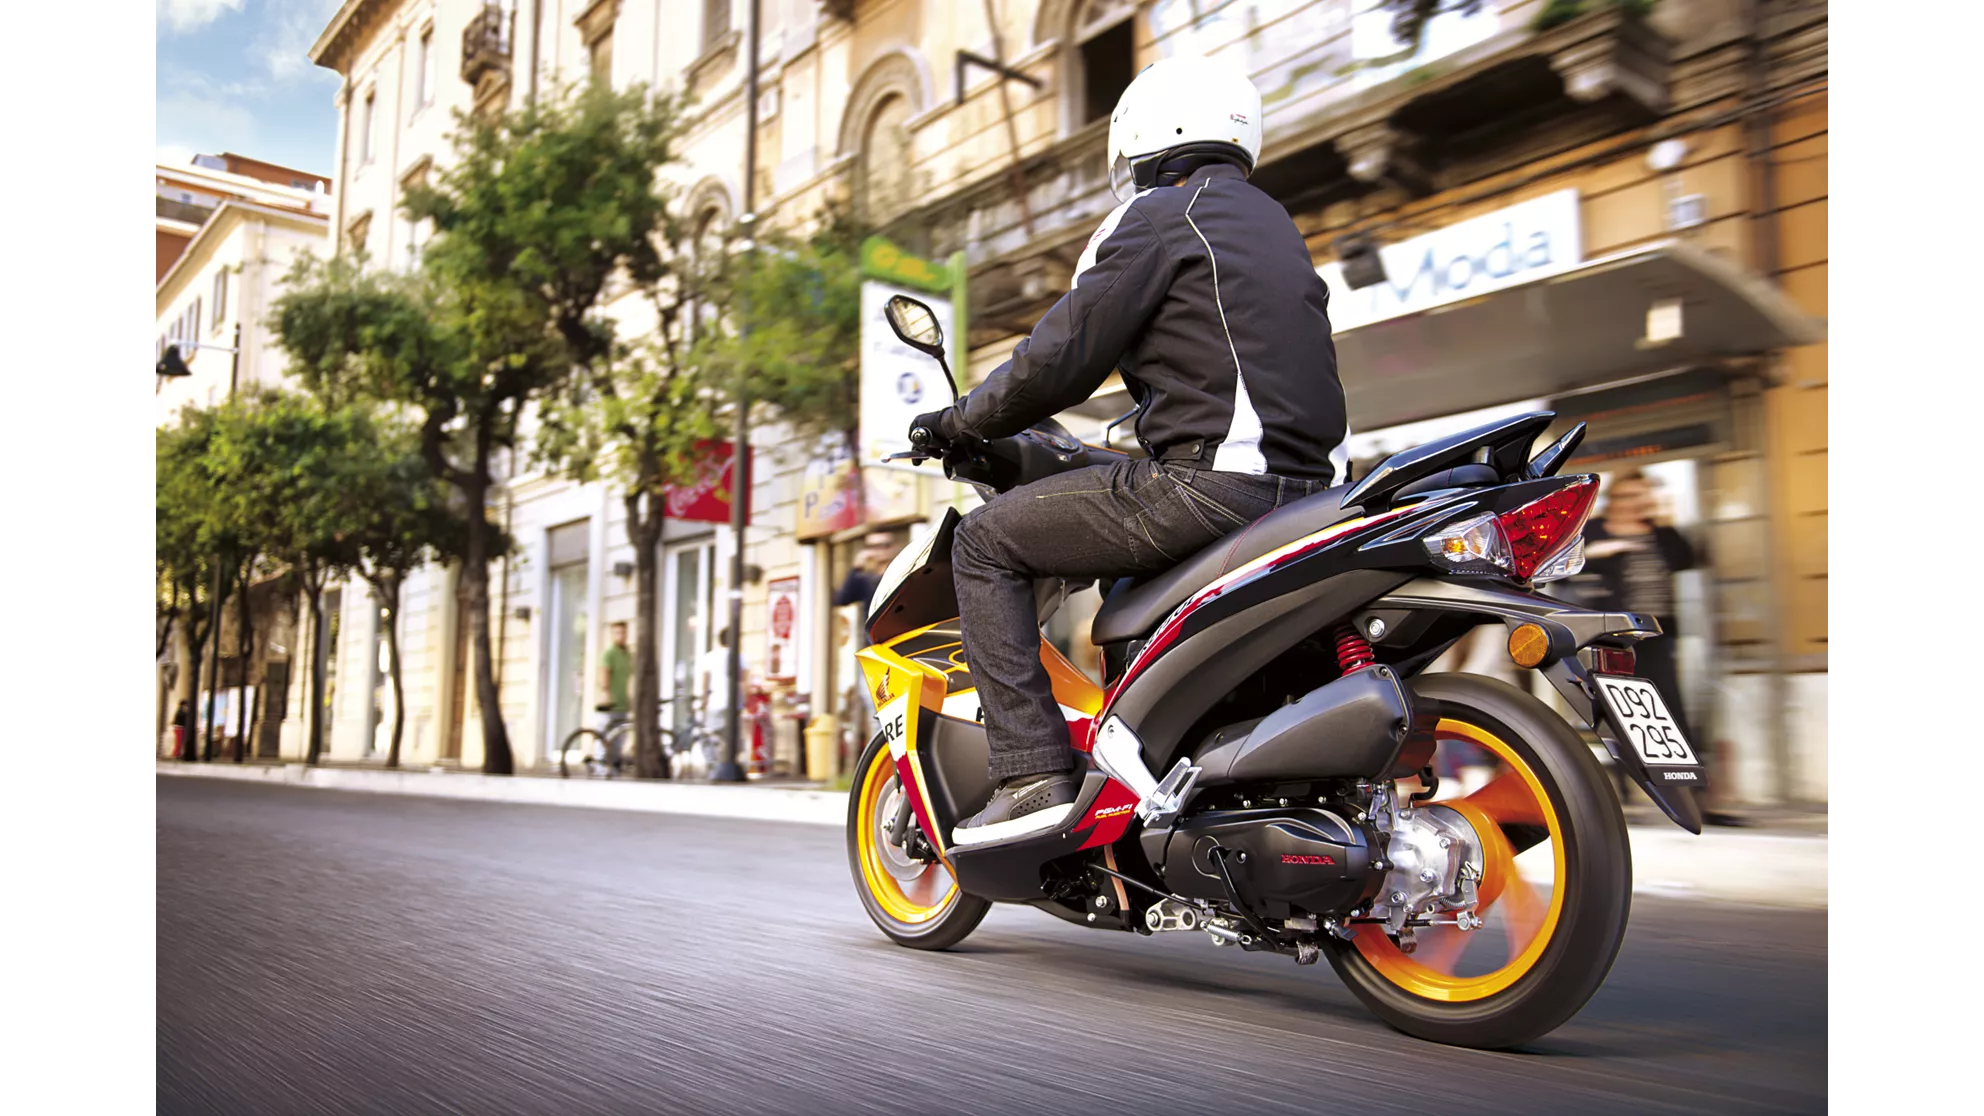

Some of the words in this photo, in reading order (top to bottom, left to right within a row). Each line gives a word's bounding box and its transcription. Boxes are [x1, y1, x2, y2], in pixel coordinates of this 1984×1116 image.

[1370, 221, 1554, 314] Moda
[1605, 683, 1668, 721] D92
[1629, 723, 1688, 759] 295
[1663, 772, 1698, 780] HONDA
[1281, 854, 1336, 865] HONDA
